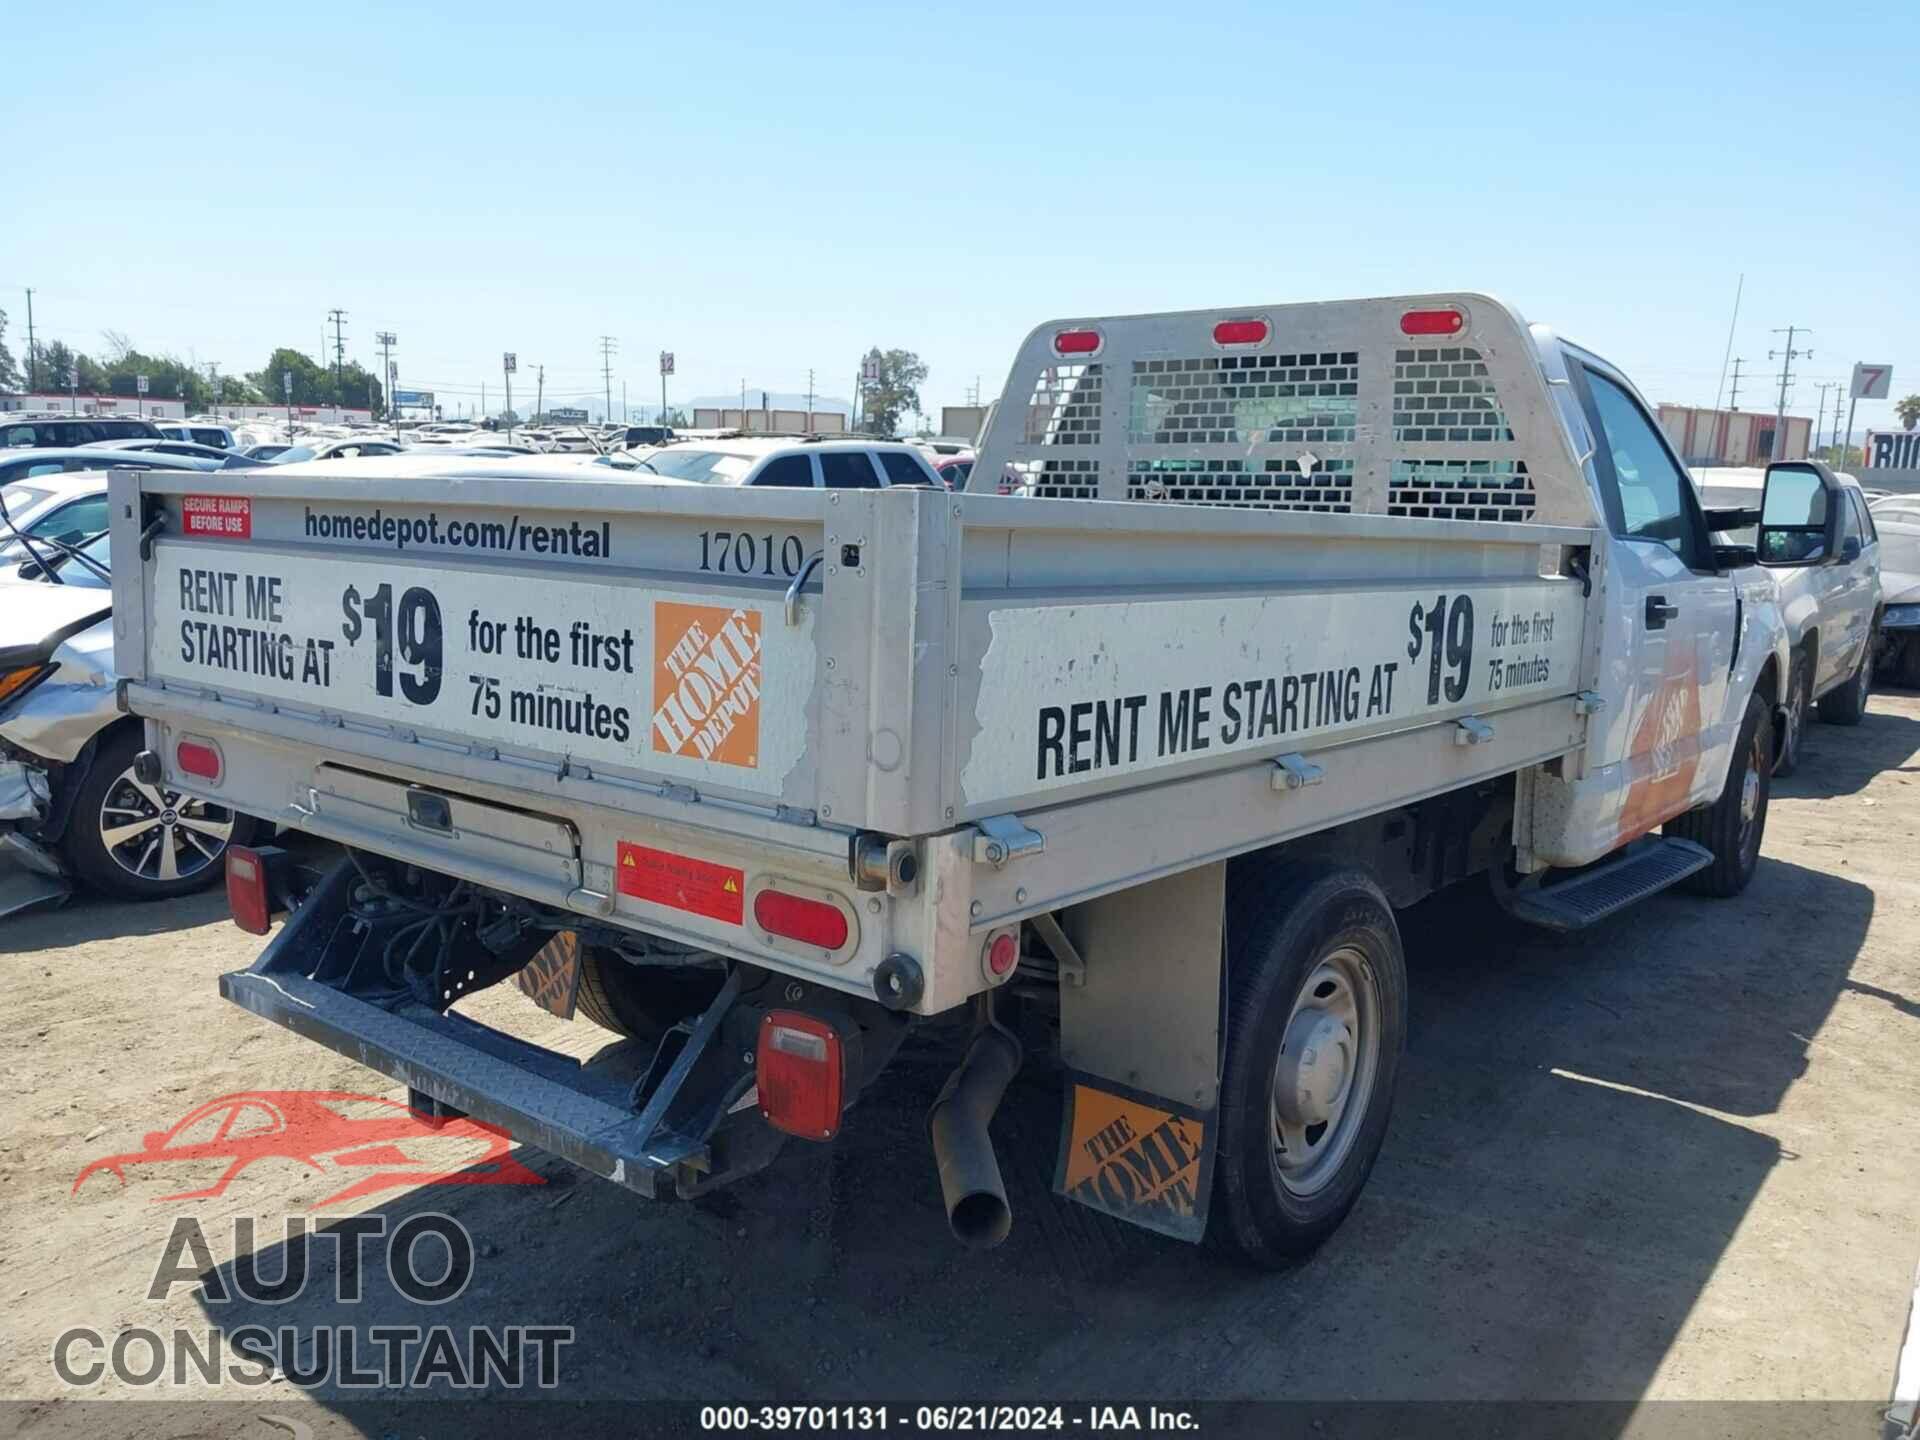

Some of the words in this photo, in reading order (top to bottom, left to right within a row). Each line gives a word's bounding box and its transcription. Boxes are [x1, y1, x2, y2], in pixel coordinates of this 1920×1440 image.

[661, 358, 674, 373] 12
[862, 362, 880, 379] 11
[1861, 368, 1884, 395] 7
[184, 498, 217, 513] SECURE
[218, 500, 249, 514] RAMPS
[190, 516, 223, 531] BEFORE
[225, 518, 242, 532] USE
[305, 507, 610, 558] homedepot.com/rental
[699, 531, 803, 577] 17010
[180, 568, 237, 616] RENT
[246, 575, 282, 623] ME
[181, 620, 293, 681] STARTING
[302, 638, 334, 687] AT
[342, 583, 443, 705] $19
[469, 609, 507, 654] for
[515, 616, 560, 663] the
[570, 622, 633, 674] first
[664, 620, 709, 680] THE
[1407, 594, 1474, 705] $19
[1491, 615, 1510, 648] for
[1511, 613, 1529, 645] the
[1532, 611, 1554, 643] first
[653, 609, 761, 754] HOME
[1489, 659, 1504, 691] 75
[1505, 654, 1549, 688] minutes
[469, 675, 500, 718] 75
[510, 684, 630, 742] minutes
[693, 662, 761, 760] DEPOT
[1037, 695, 1147, 780] RENT
[1158, 686, 1212, 757] ME
[1221, 664, 1360, 744] STARTING
[1366, 662, 1398, 718] AT
[1083, 1114, 1137, 1164] THE
